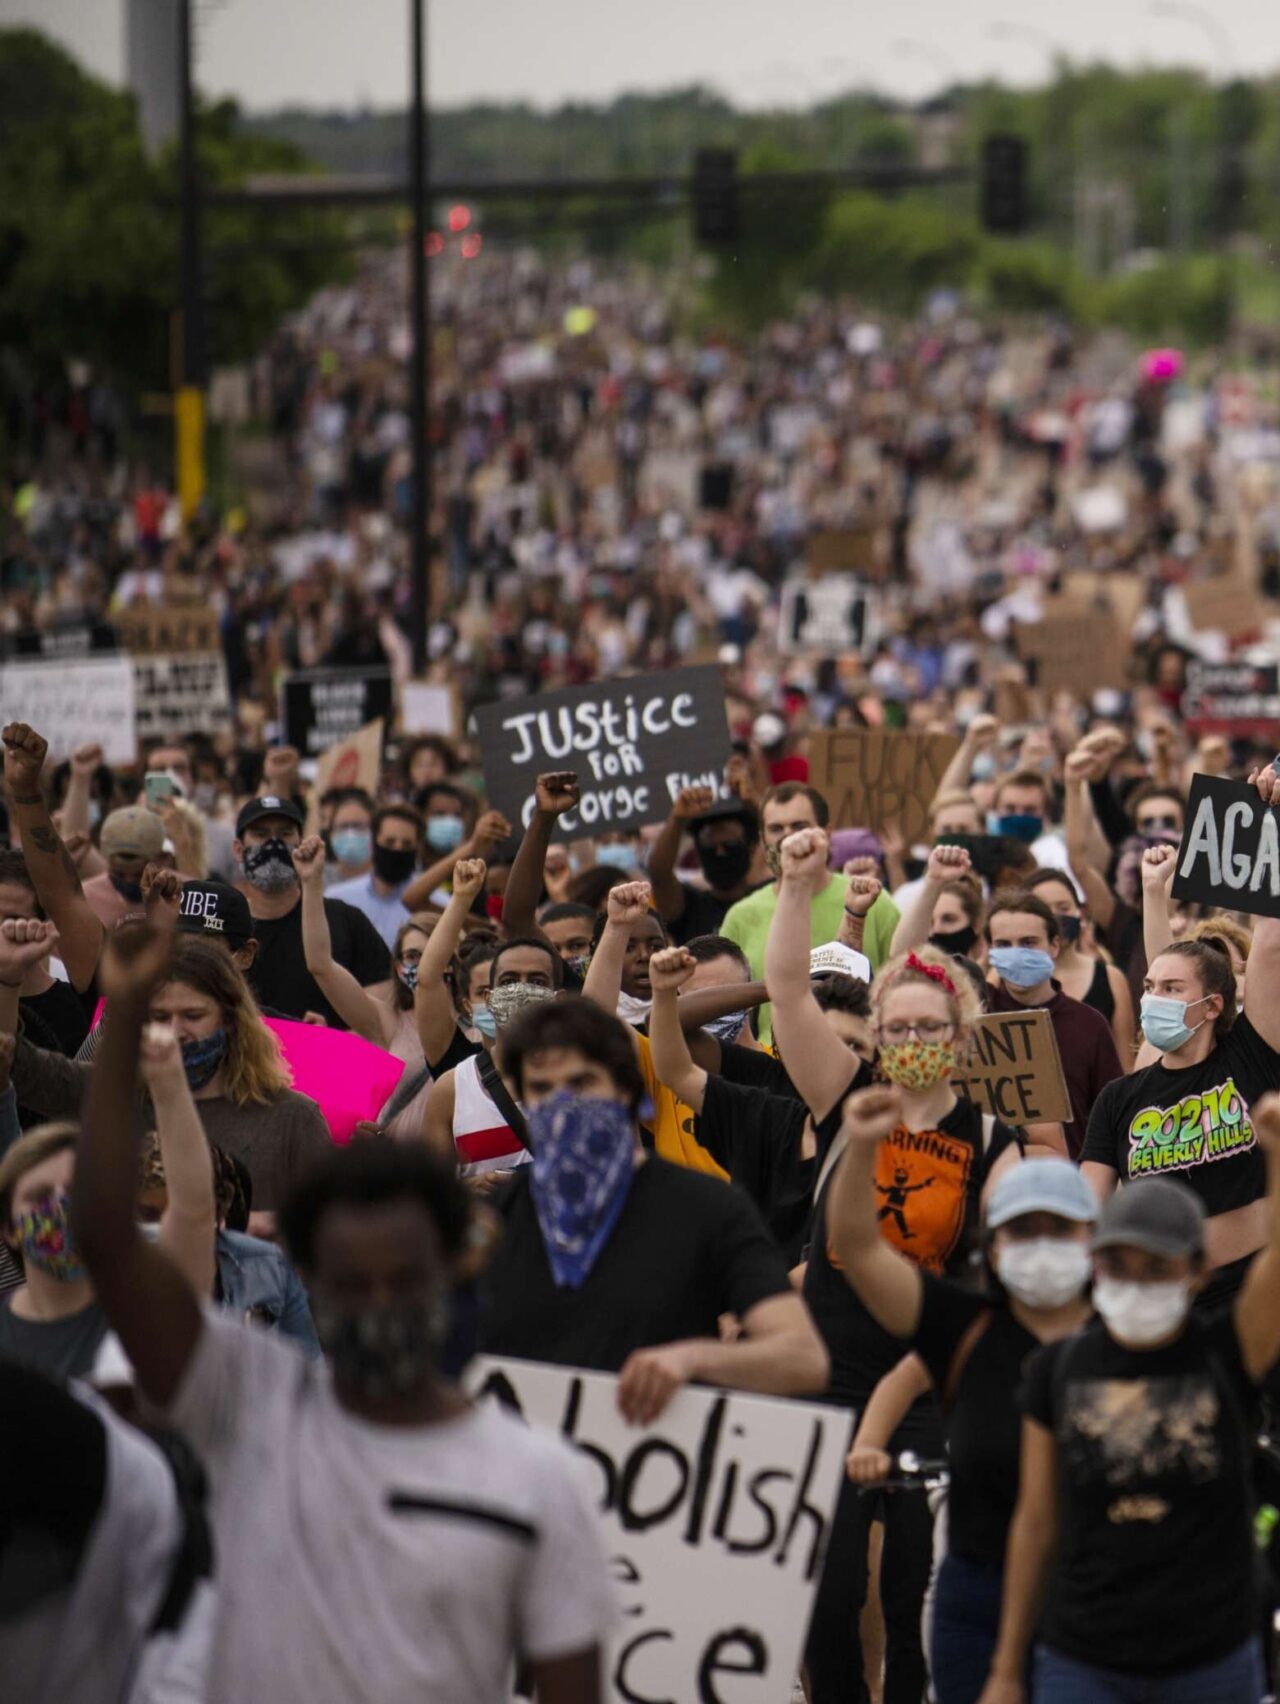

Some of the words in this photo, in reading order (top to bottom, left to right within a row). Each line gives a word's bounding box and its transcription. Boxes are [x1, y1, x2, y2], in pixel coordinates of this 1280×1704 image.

[826, 734, 944, 790] FUCK
[1131, 1080, 1242, 1149] 90210
[1130, 1138, 1204, 1171] BEVERLY
[1207, 1121, 1253, 1154] HILLS
